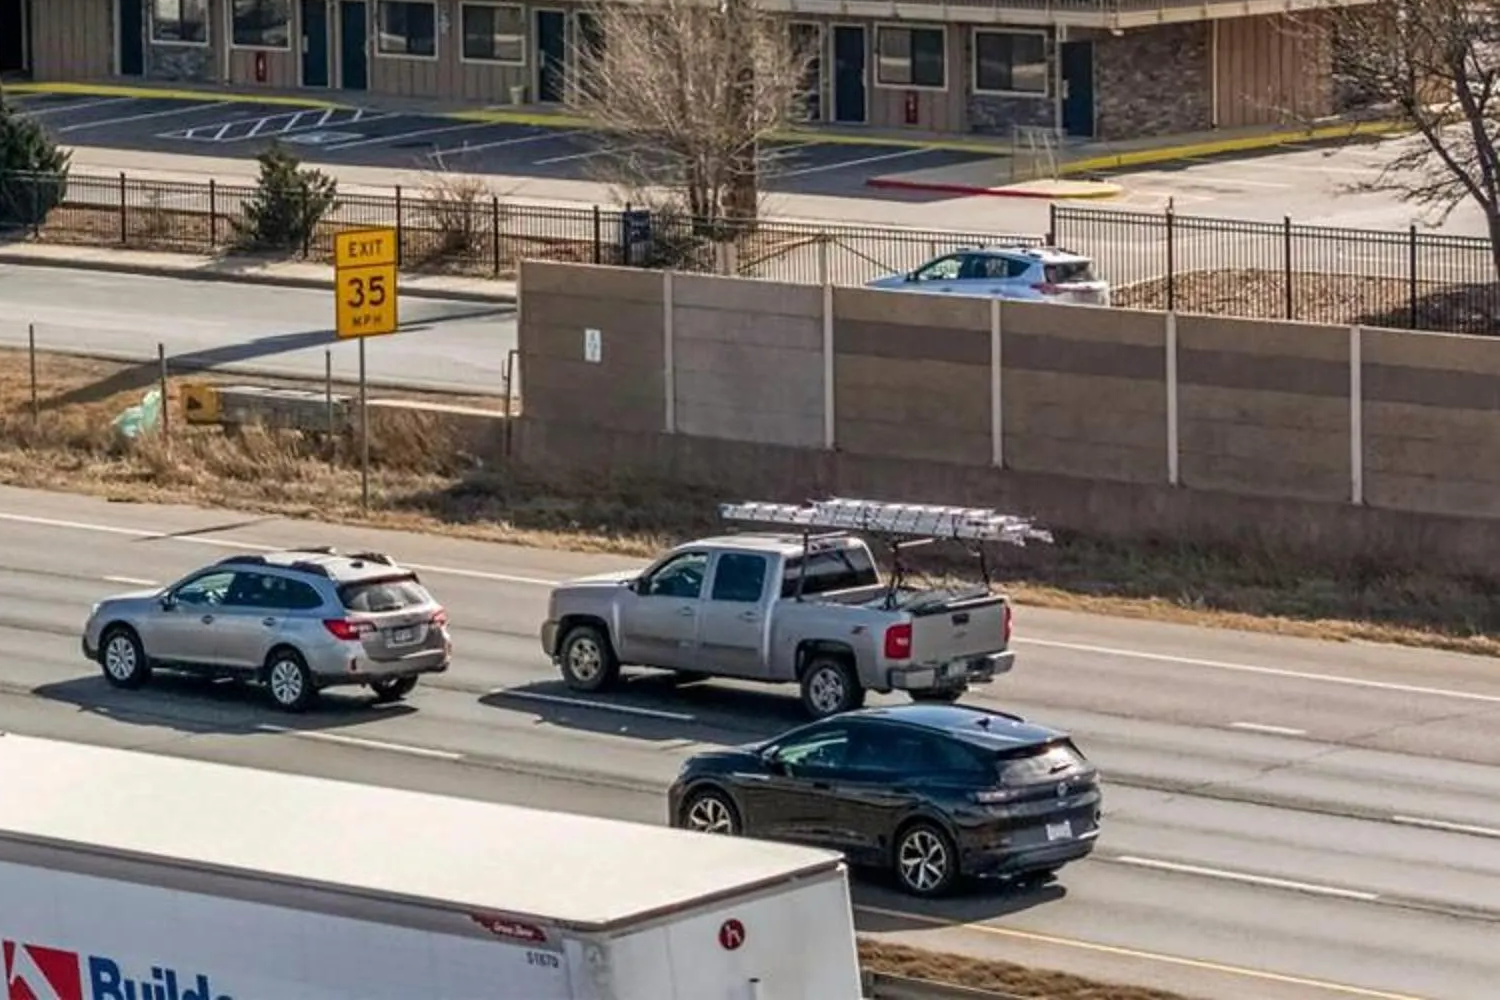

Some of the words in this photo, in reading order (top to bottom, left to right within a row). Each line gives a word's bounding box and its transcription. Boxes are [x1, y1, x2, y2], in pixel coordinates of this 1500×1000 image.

[348, 238, 384, 258] EXIT
[347, 275, 386, 308] 35
[352, 313, 382, 327] MPH
